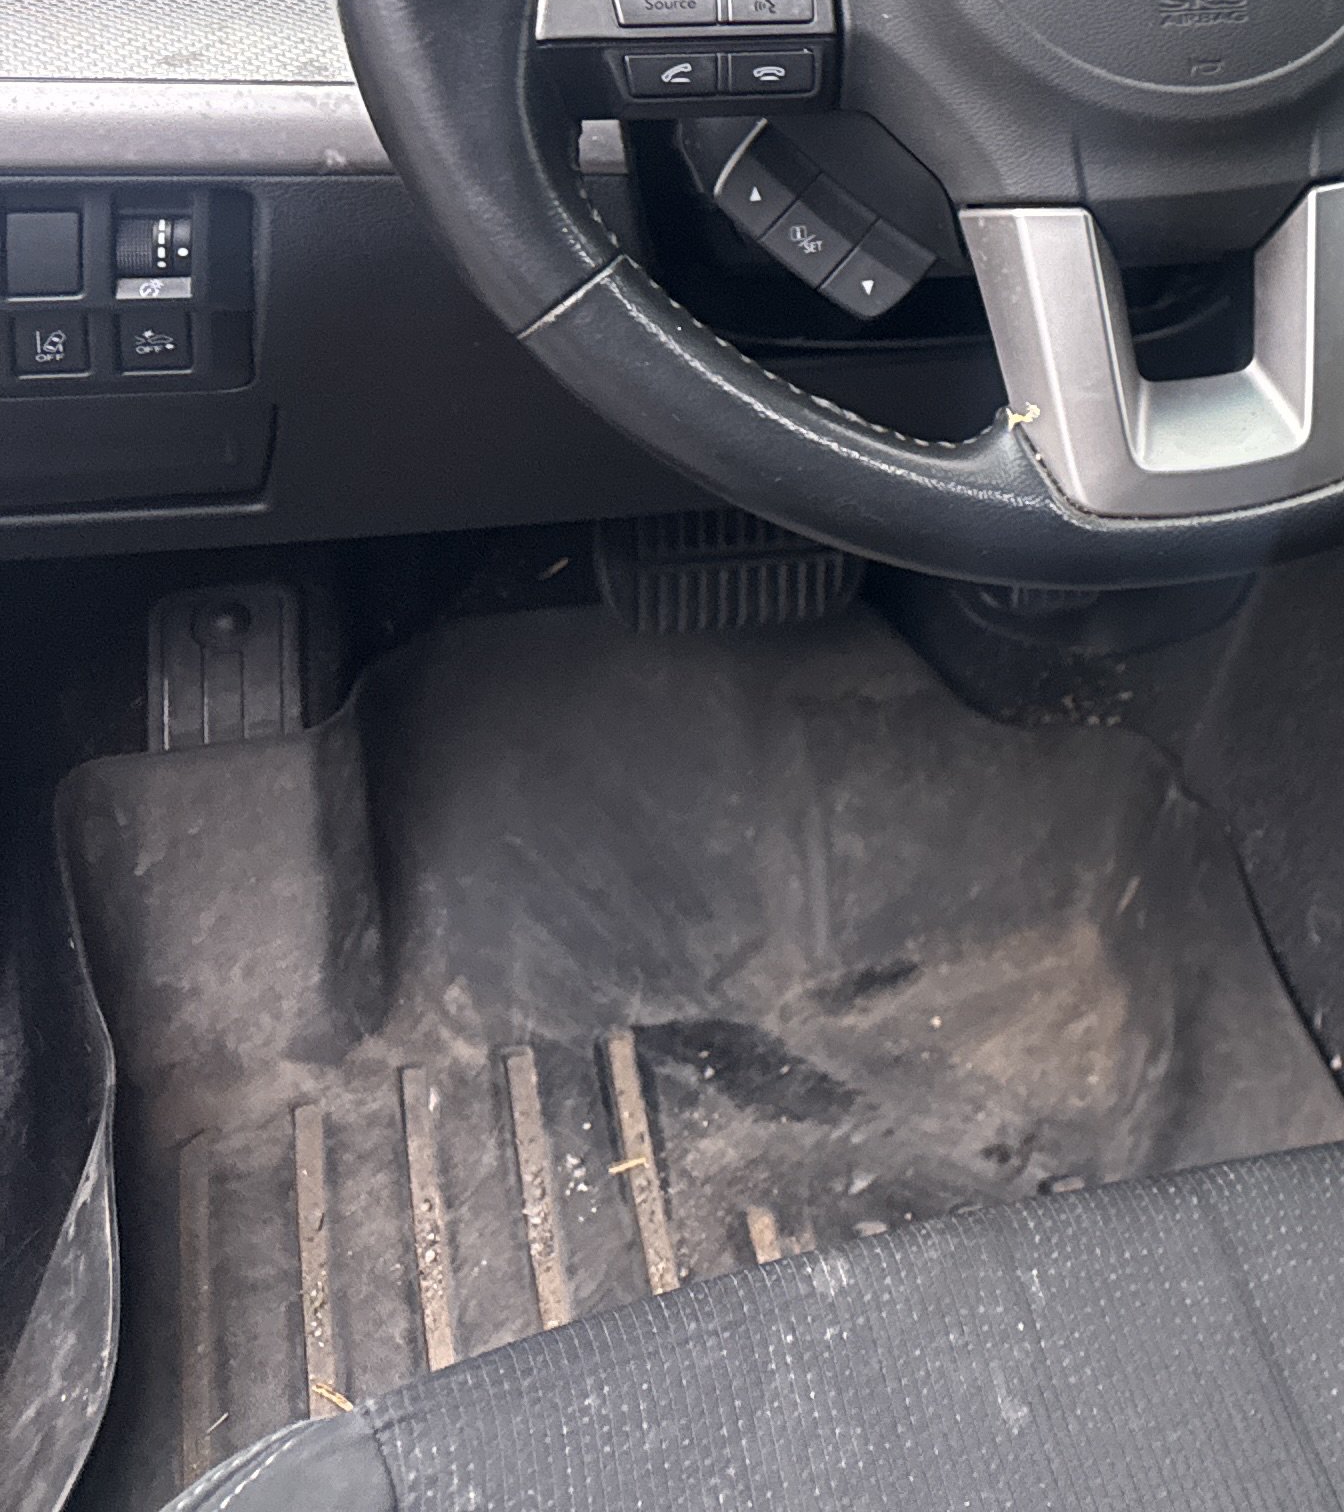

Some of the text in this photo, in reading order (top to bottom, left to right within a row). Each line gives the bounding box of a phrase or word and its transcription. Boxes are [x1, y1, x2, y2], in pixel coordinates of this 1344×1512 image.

[1160, 11, 1250, 29] AIRBAG
[136, 344, 165, 355] OFF
[35, 353, 66, 363] OFF
